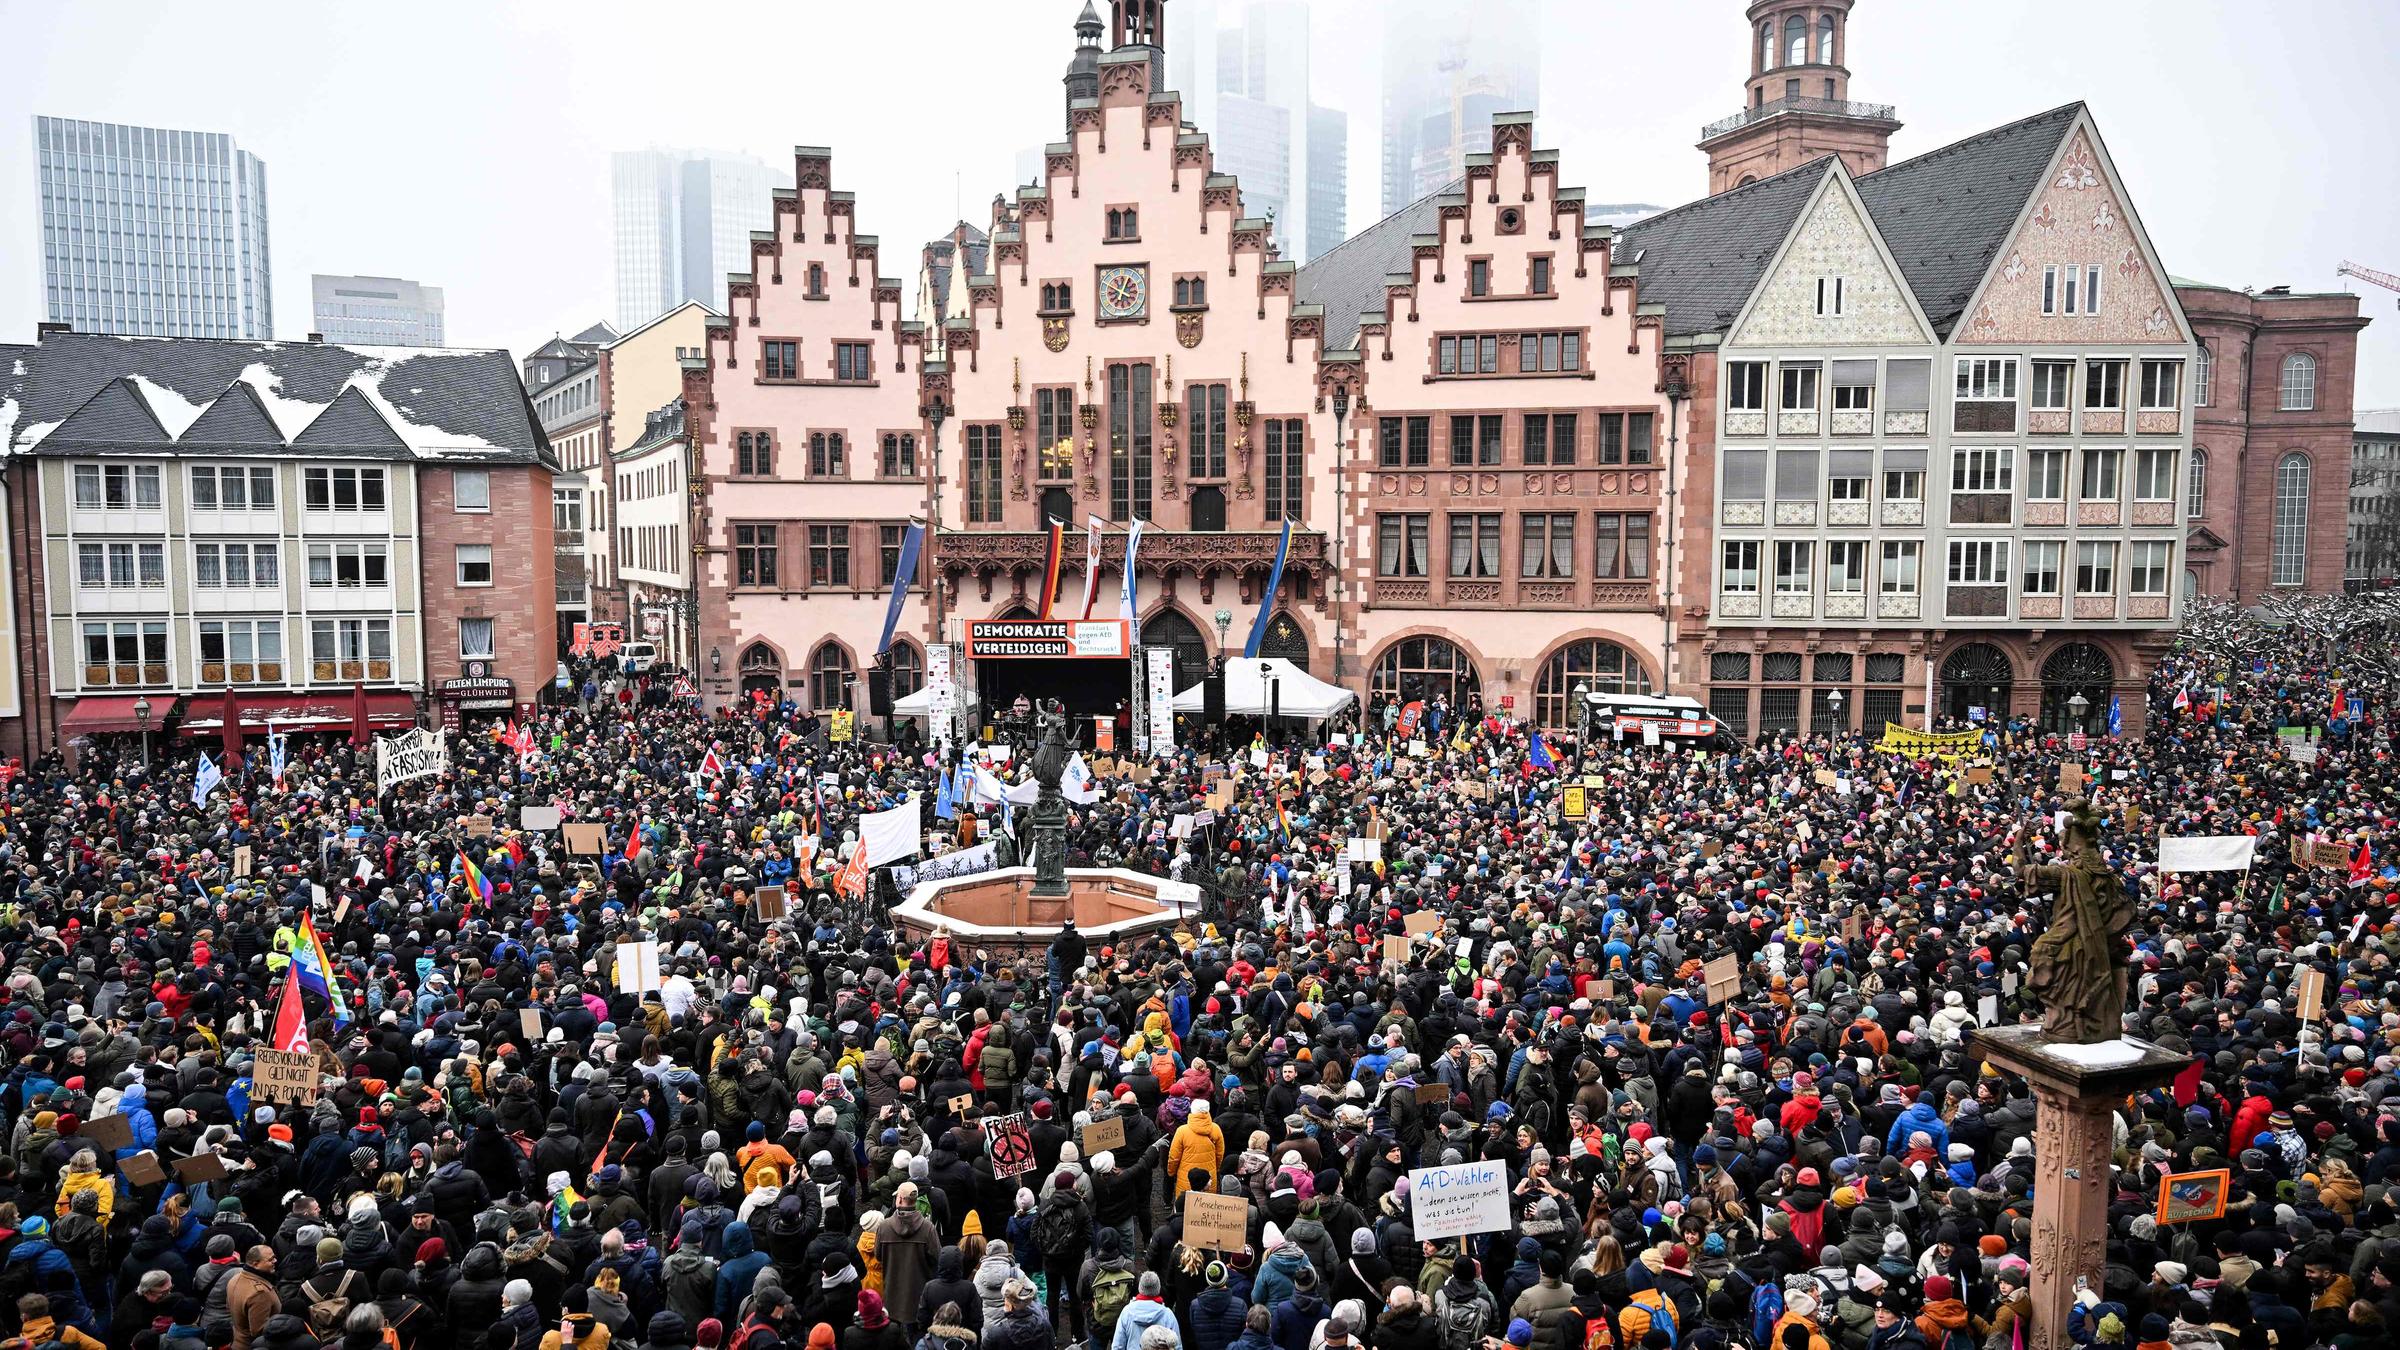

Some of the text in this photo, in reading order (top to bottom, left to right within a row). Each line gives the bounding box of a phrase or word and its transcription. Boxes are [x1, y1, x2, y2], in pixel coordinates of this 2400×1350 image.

[973, 625, 1066, 637] DEMOKRATIE
[973, 643, 1066, 654] VERTEIDIGEN!
[446, 678, 509, 689] ALTEN LIMPURG
[461, 688, 508, 697] GLÜHWEIN
[1890, 726, 1904, 734] KEIN
[1905, 730, 1923, 738] PLATZ
[257, 1049, 315, 1068] RECHTS VOR LINKS
[268, 1066, 310, 1083] GILT NICHT
[264, 1083, 280, 1100] DER
[985, 1111, 1028, 1139] FRIEDEN
[1096, 1128, 1119, 1142] NAZIS
[1419, 1167, 1498, 1192] AfD-Wähler:
[1448, 1195, 1458, 1203] sie
[1459, 1191, 1480, 1200] wissen
[1193, 1196, 1244, 1212] Menschenrechte
[1424, 1210, 1440, 1219] was
[1445, 1208, 1455, 1216] sie
[1190, 1219, 1212, 1228] rechte
